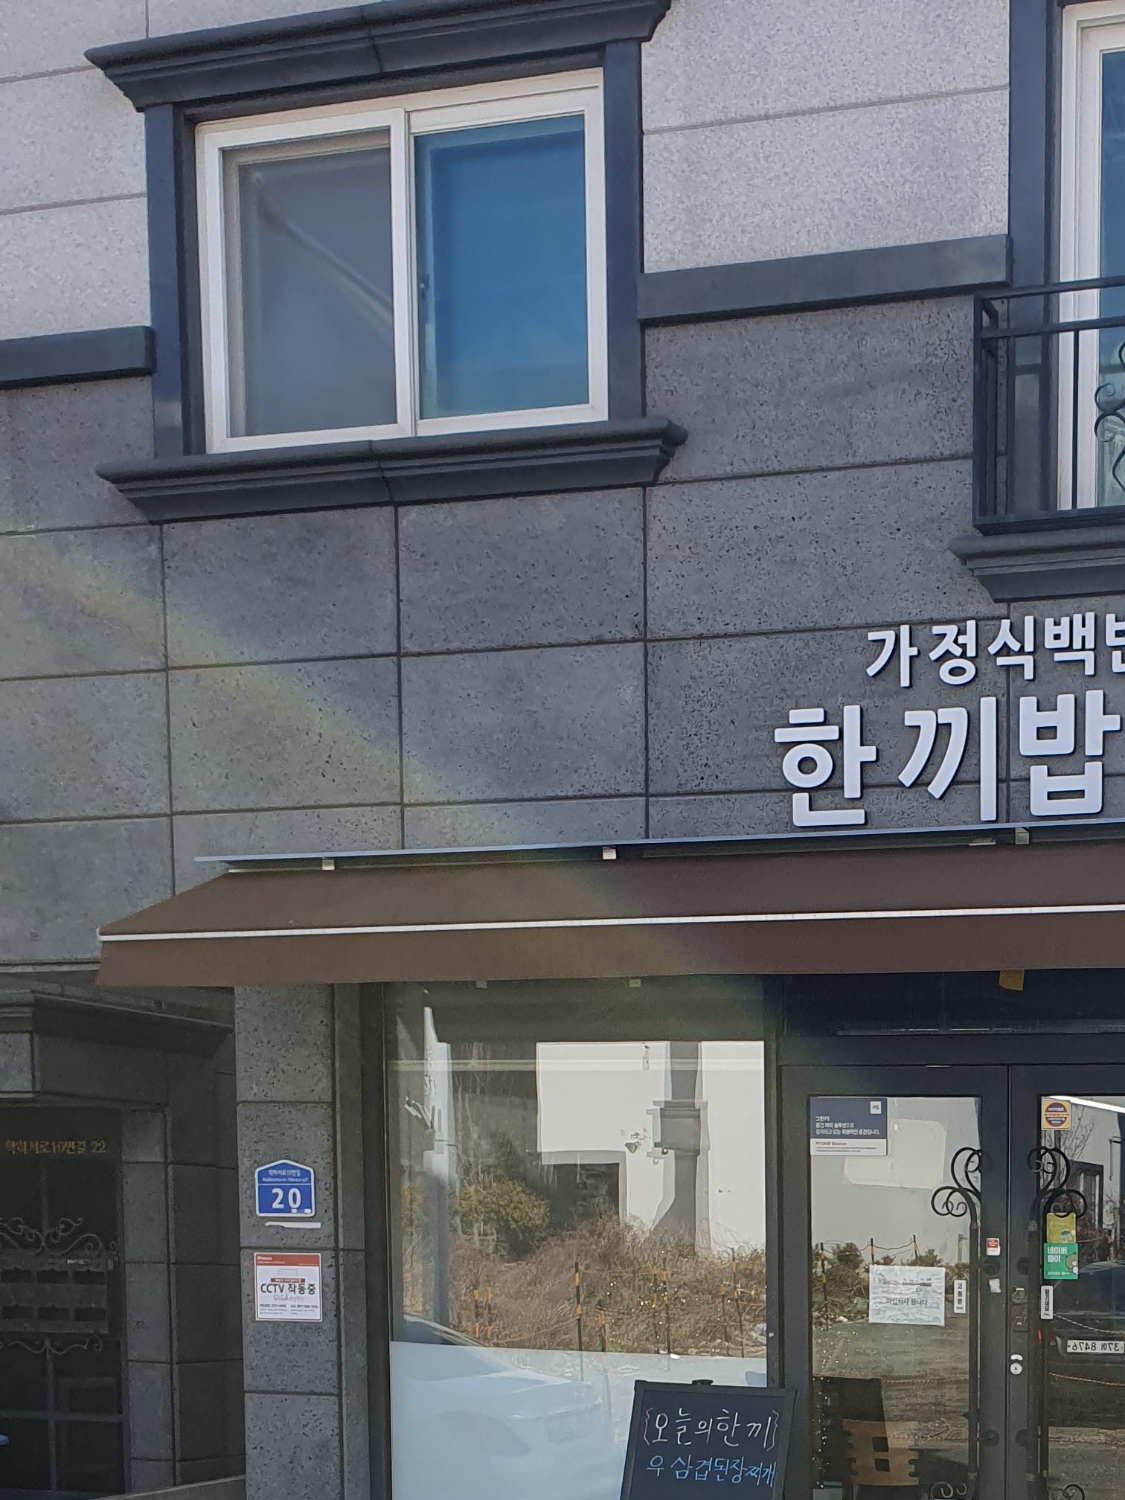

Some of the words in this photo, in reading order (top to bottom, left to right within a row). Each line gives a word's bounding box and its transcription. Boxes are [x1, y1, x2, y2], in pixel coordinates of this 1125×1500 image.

[90, 1139, 107, 1154] 22
[271, 1187, 302, 1209] 20
[1047, 1246, 1068, 1255] 네이버
[260, 1283, 285, 1294] CCTV
[287, 1283, 316, 1295] 작동중
